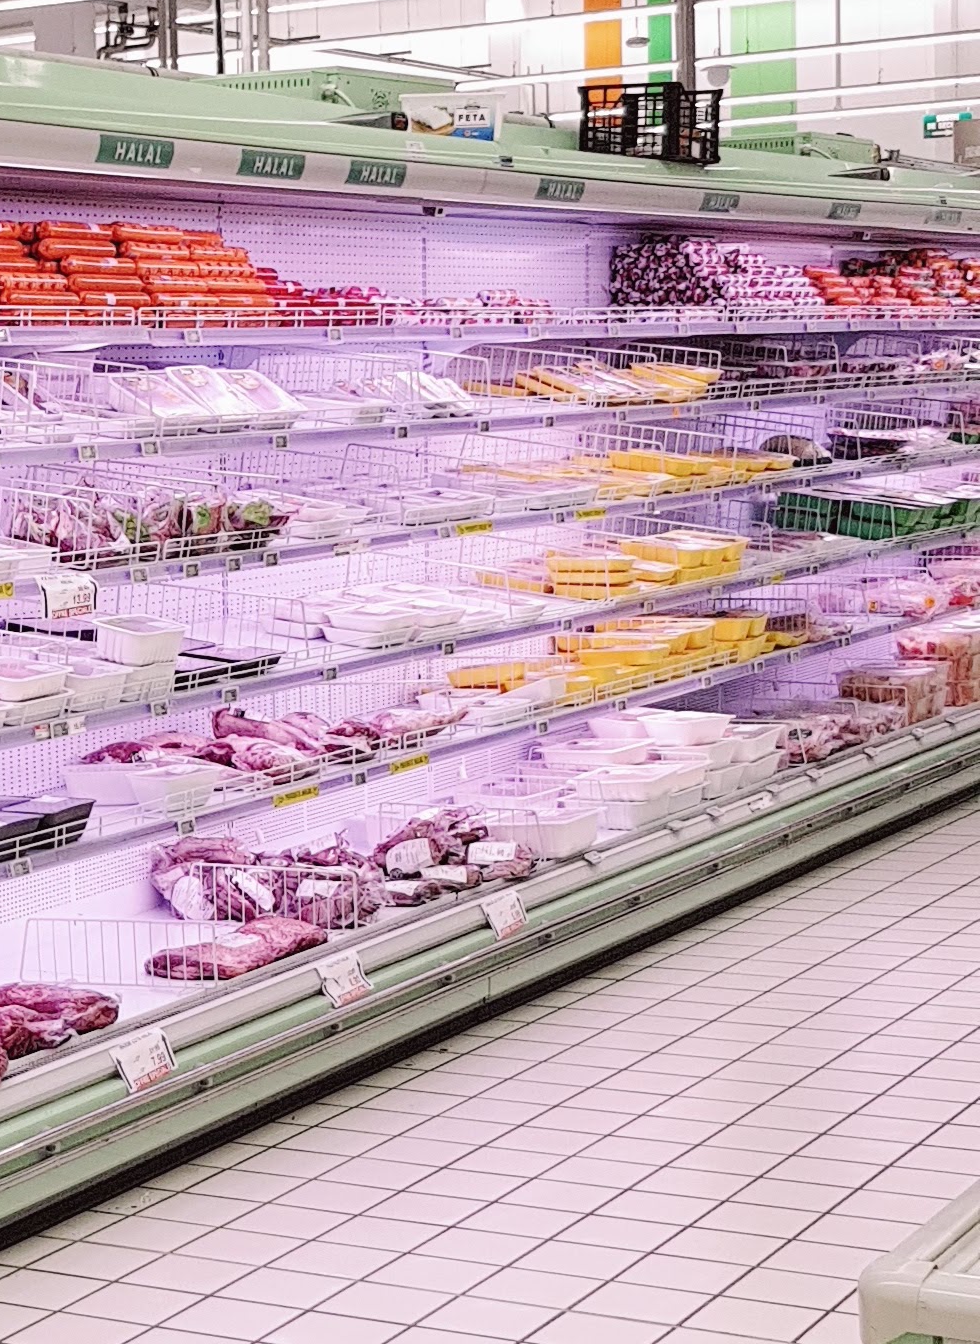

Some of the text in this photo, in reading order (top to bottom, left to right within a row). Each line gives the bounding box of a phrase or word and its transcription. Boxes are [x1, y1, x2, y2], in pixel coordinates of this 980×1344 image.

[458, 113, 486, 122] FETA
[114, 142, 162, 164] HALAL
[253, 156, 295, 177] HALAL
[360, 165, 399, 184] HALAL
